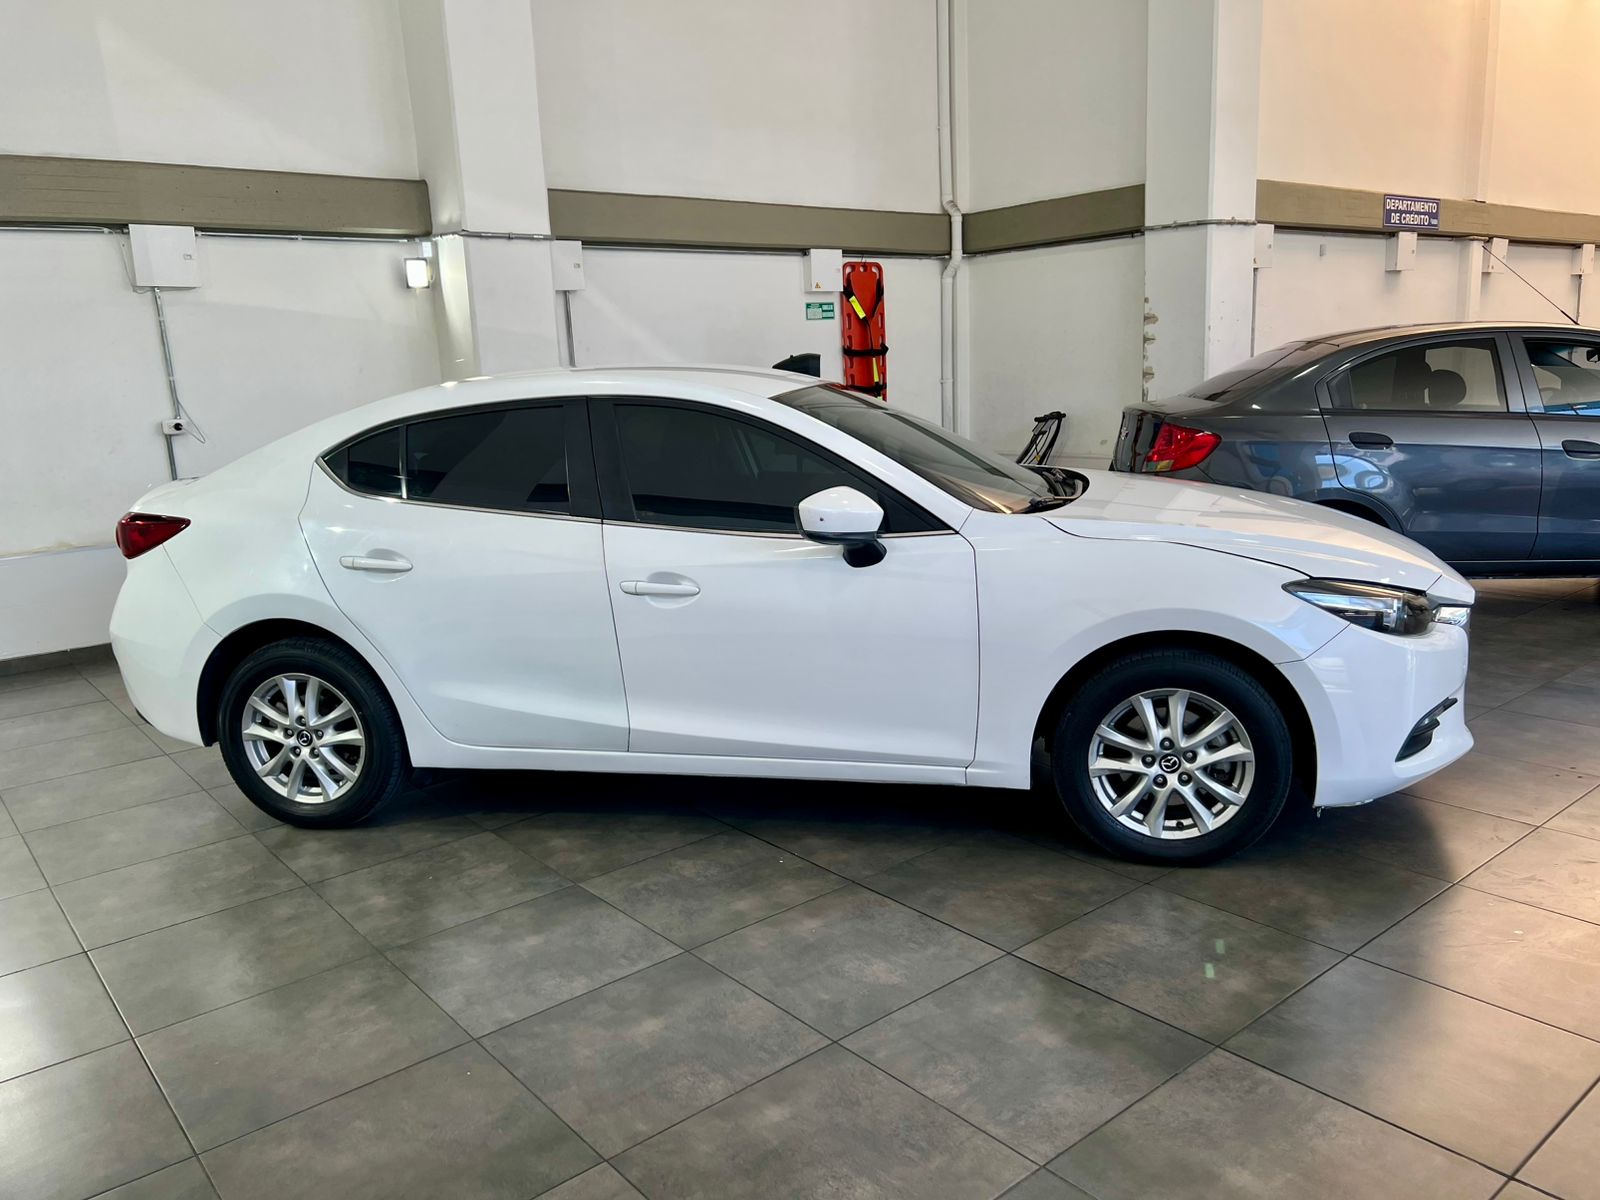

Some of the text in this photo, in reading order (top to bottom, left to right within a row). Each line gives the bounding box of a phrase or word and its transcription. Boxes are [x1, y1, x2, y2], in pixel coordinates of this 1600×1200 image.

[1386, 199, 1437, 213] DEPARTAMENTO
[1391, 213, 1400, 223] DE
[1401, 212, 1429, 225] CRÉDITO
